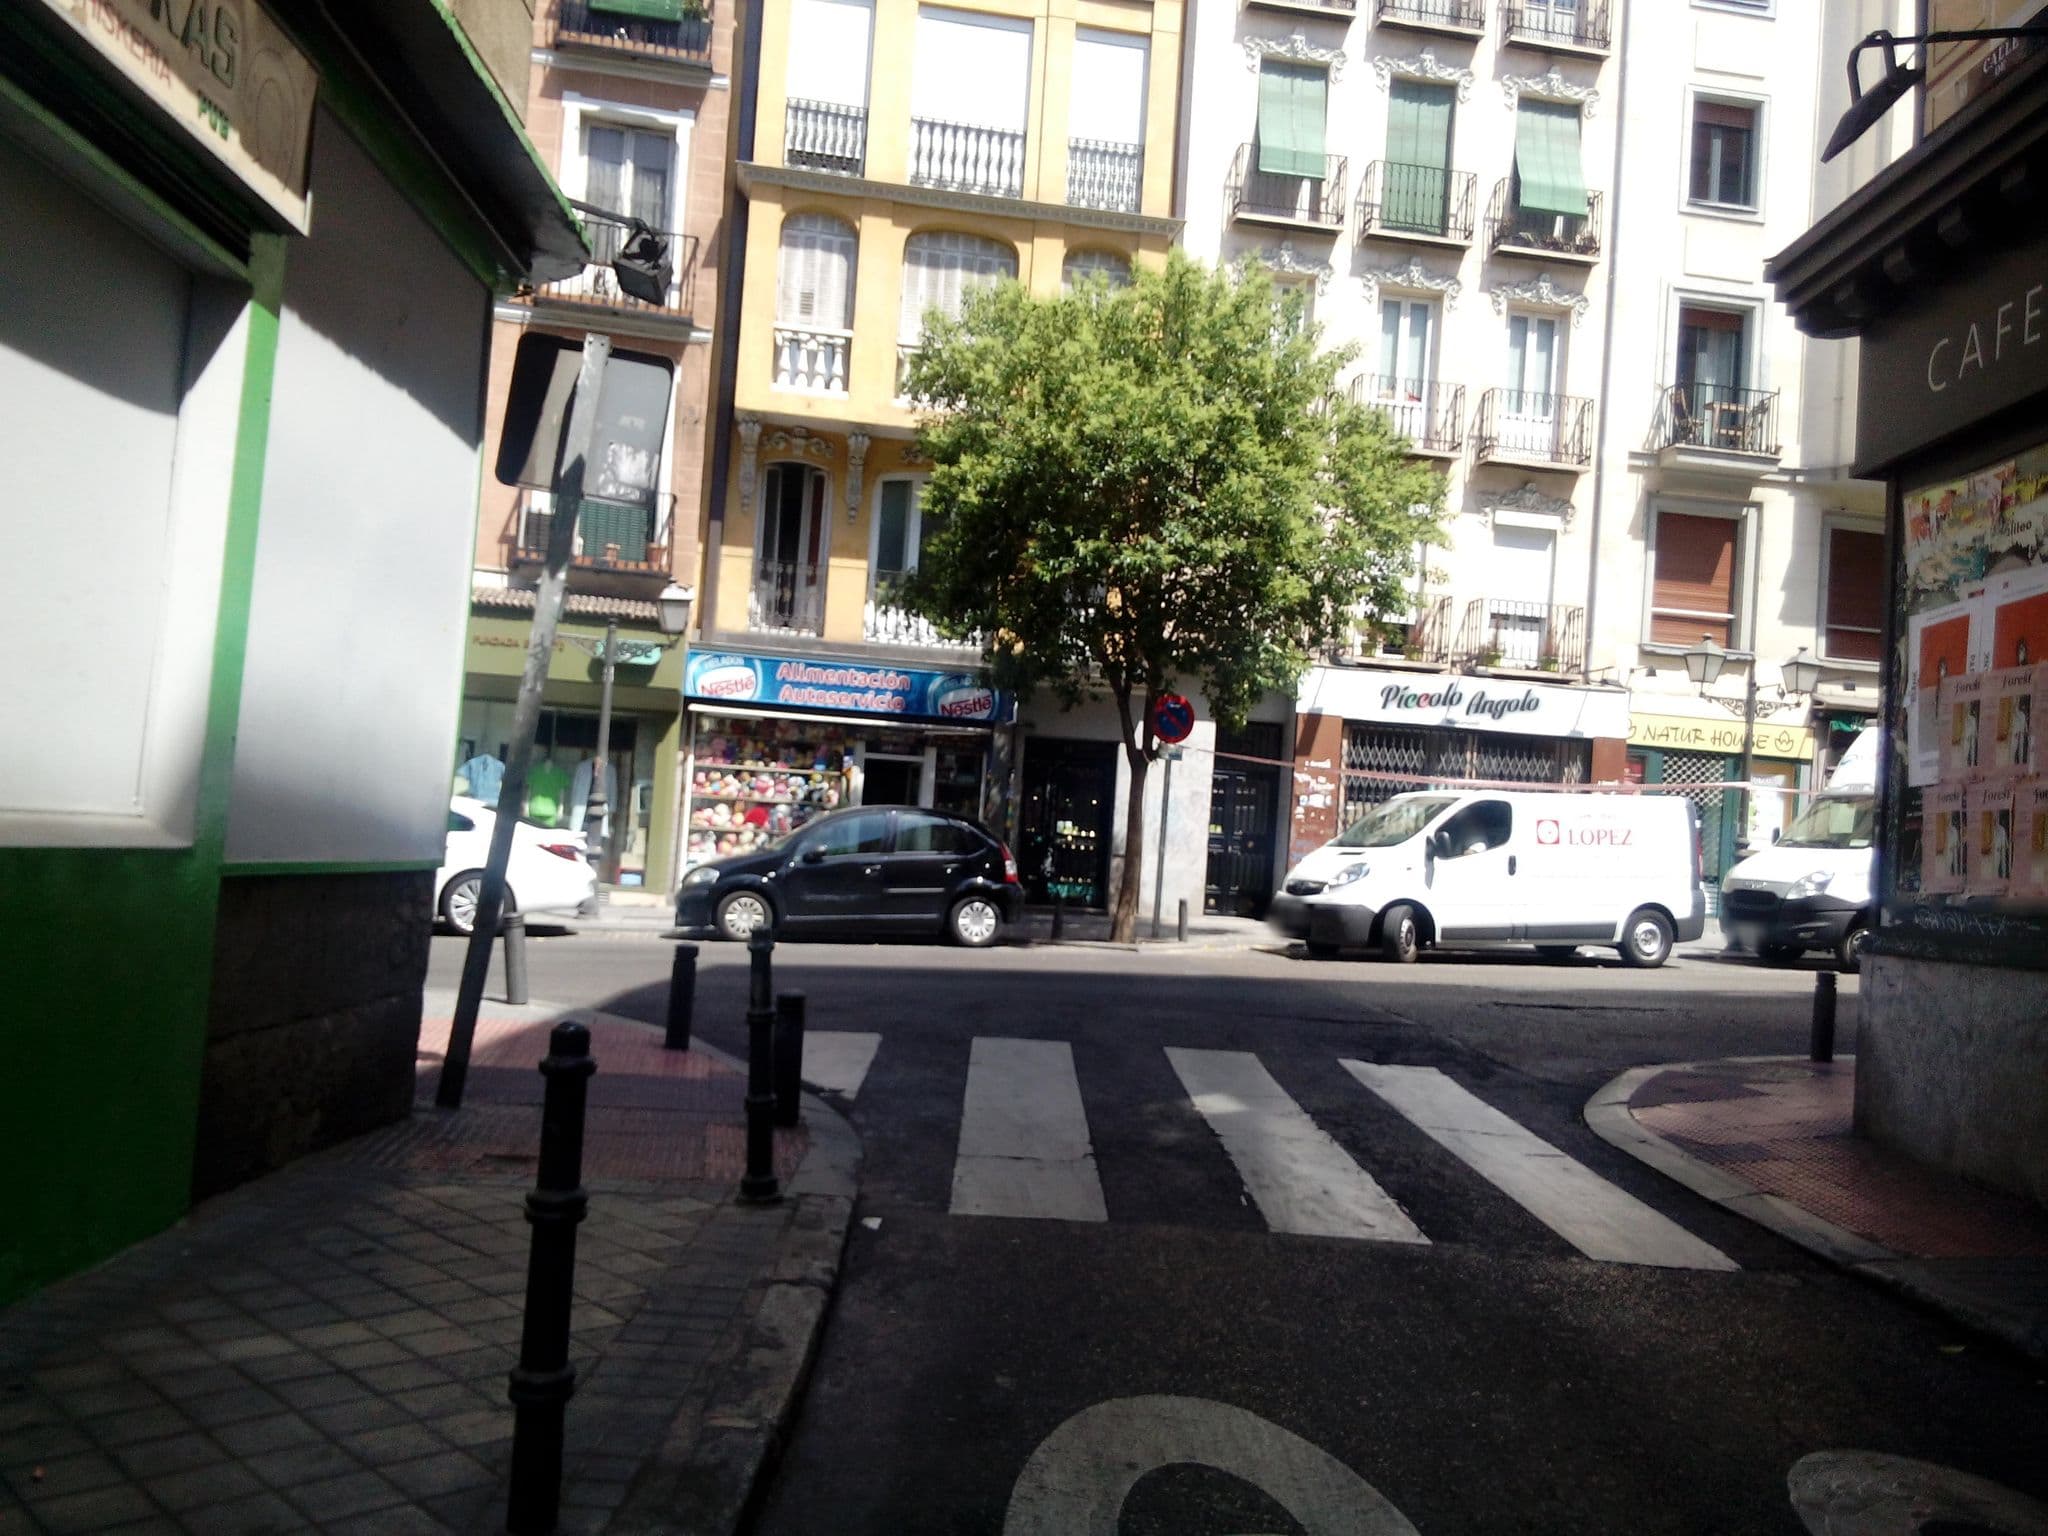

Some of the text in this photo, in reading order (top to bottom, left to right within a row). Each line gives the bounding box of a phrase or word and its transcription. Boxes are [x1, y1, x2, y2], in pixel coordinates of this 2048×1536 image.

[1927, 284, 2043, 393] CAFE
[701, 674, 756, 696] Nestlé
[776, 662, 911, 691] Alimentación
[779, 684, 906, 711] Autoservicio
[940, 694, 993, 716] Nestlé
[1380, 683, 1540, 720] Piccolo Angolo
[1642, 724, 1705, 744] NATUR
[1568, 828, 1633, 846] LOPEZ
